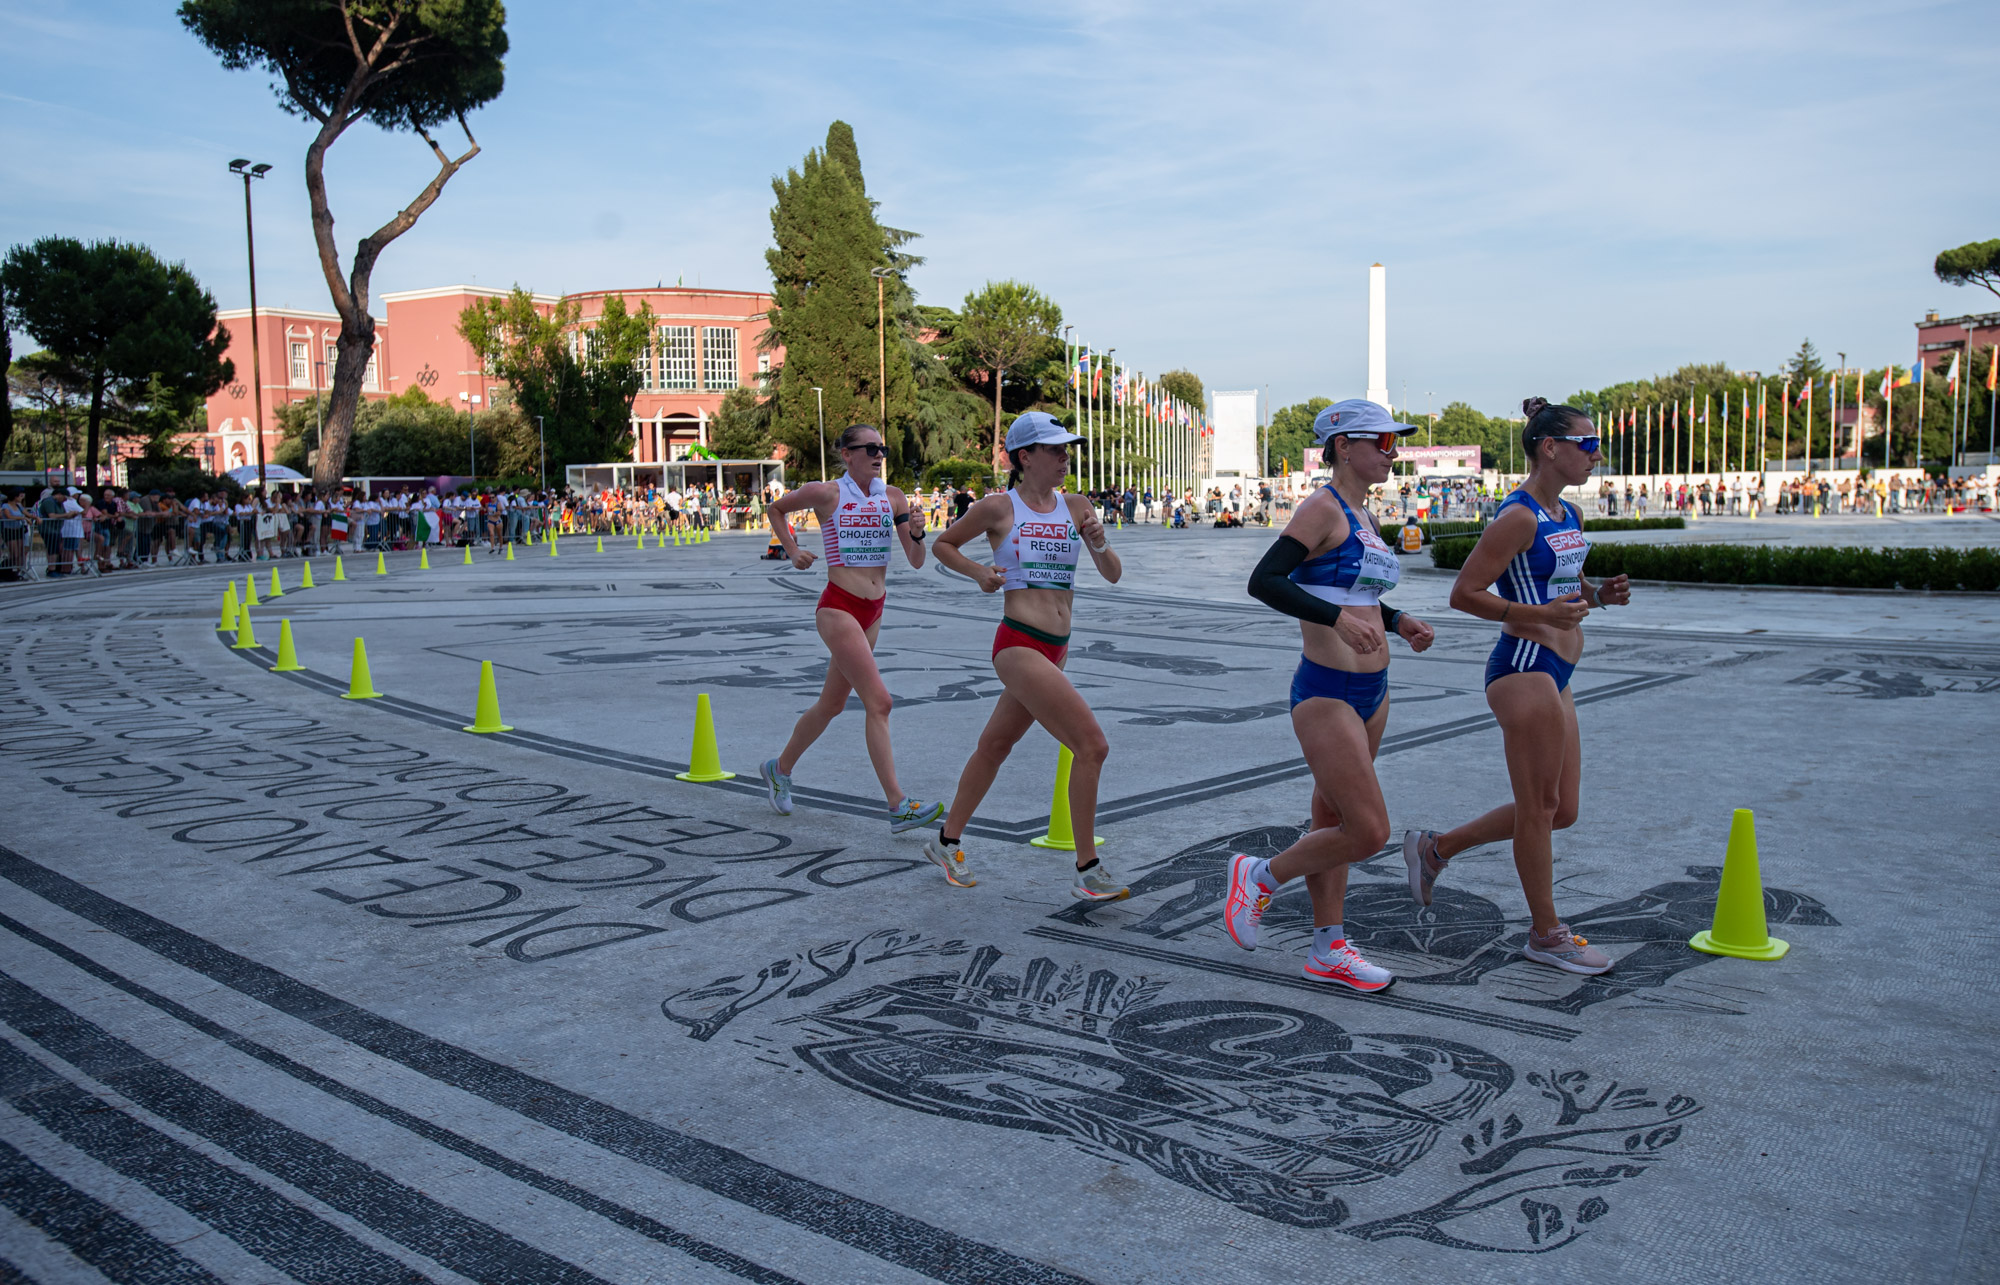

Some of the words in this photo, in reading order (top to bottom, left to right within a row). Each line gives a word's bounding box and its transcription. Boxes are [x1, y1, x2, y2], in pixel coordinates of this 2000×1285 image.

[841, 516, 880, 526] SPAR
[840, 530, 890, 539] CHOJECKA
[1022, 524, 1066, 538] SPAR
[1550, 533, 1584, 550] SPAR
[1029, 571, 1052, 579] ROMA
[1054, 572, 1072, 580] 2024
[1558, 585, 1580, 594] ROMA
